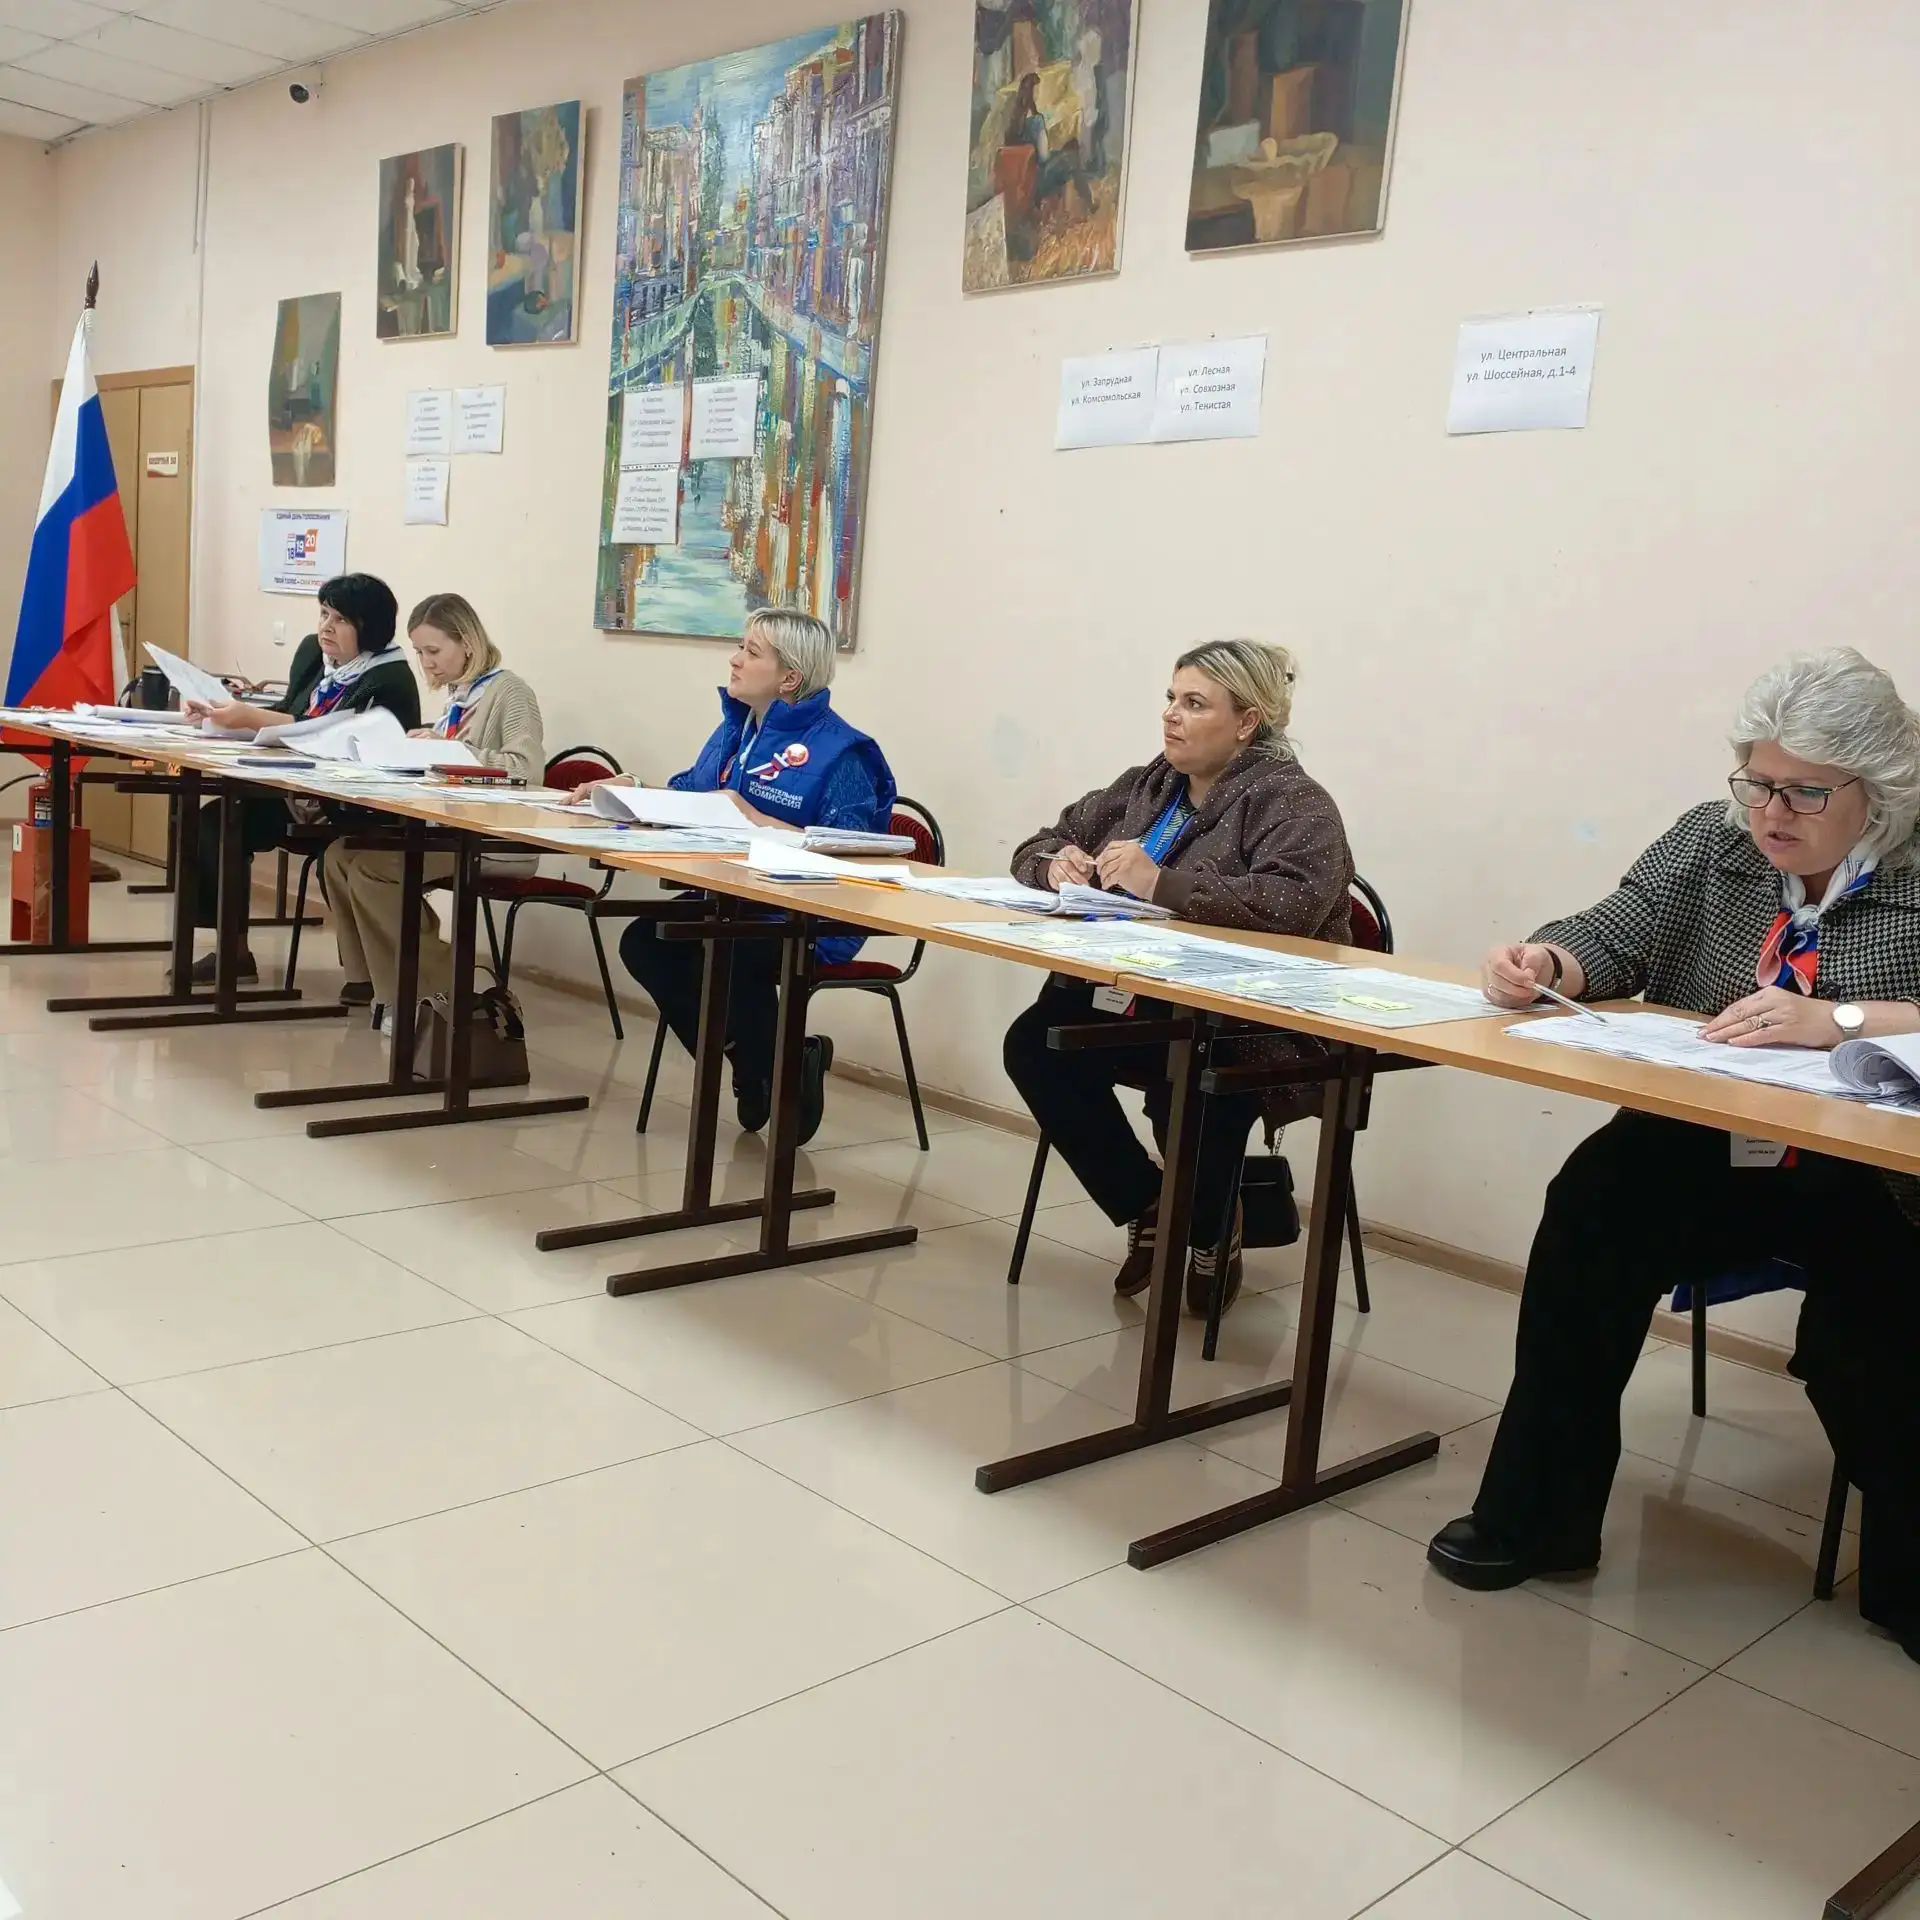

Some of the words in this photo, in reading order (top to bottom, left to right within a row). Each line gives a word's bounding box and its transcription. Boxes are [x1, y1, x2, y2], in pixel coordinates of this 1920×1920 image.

[1481, 352, 1495, 363] ул.
[1498, 347, 1567, 361] Центральная
[1201, 366, 1231, 376] Лесная
[1484, 368, 1545, 381] Шоссейная,
[1093, 376, 1133, 388] Запрудная
[1193, 383, 1236, 394] Совхозная
[1083, 391, 1141, 404] Комсомольская
[1194, 401, 1231, 411] Тенистая
[287, 547, 295, 560] 18
[296, 540, 304, 553] 19
[306, 535, 316, 548] 20
[749, 786, 801, 809] КОМИССИЯ
[750, 781, 803, 802] ИЗБИРАТЕЛЬНАЯ
